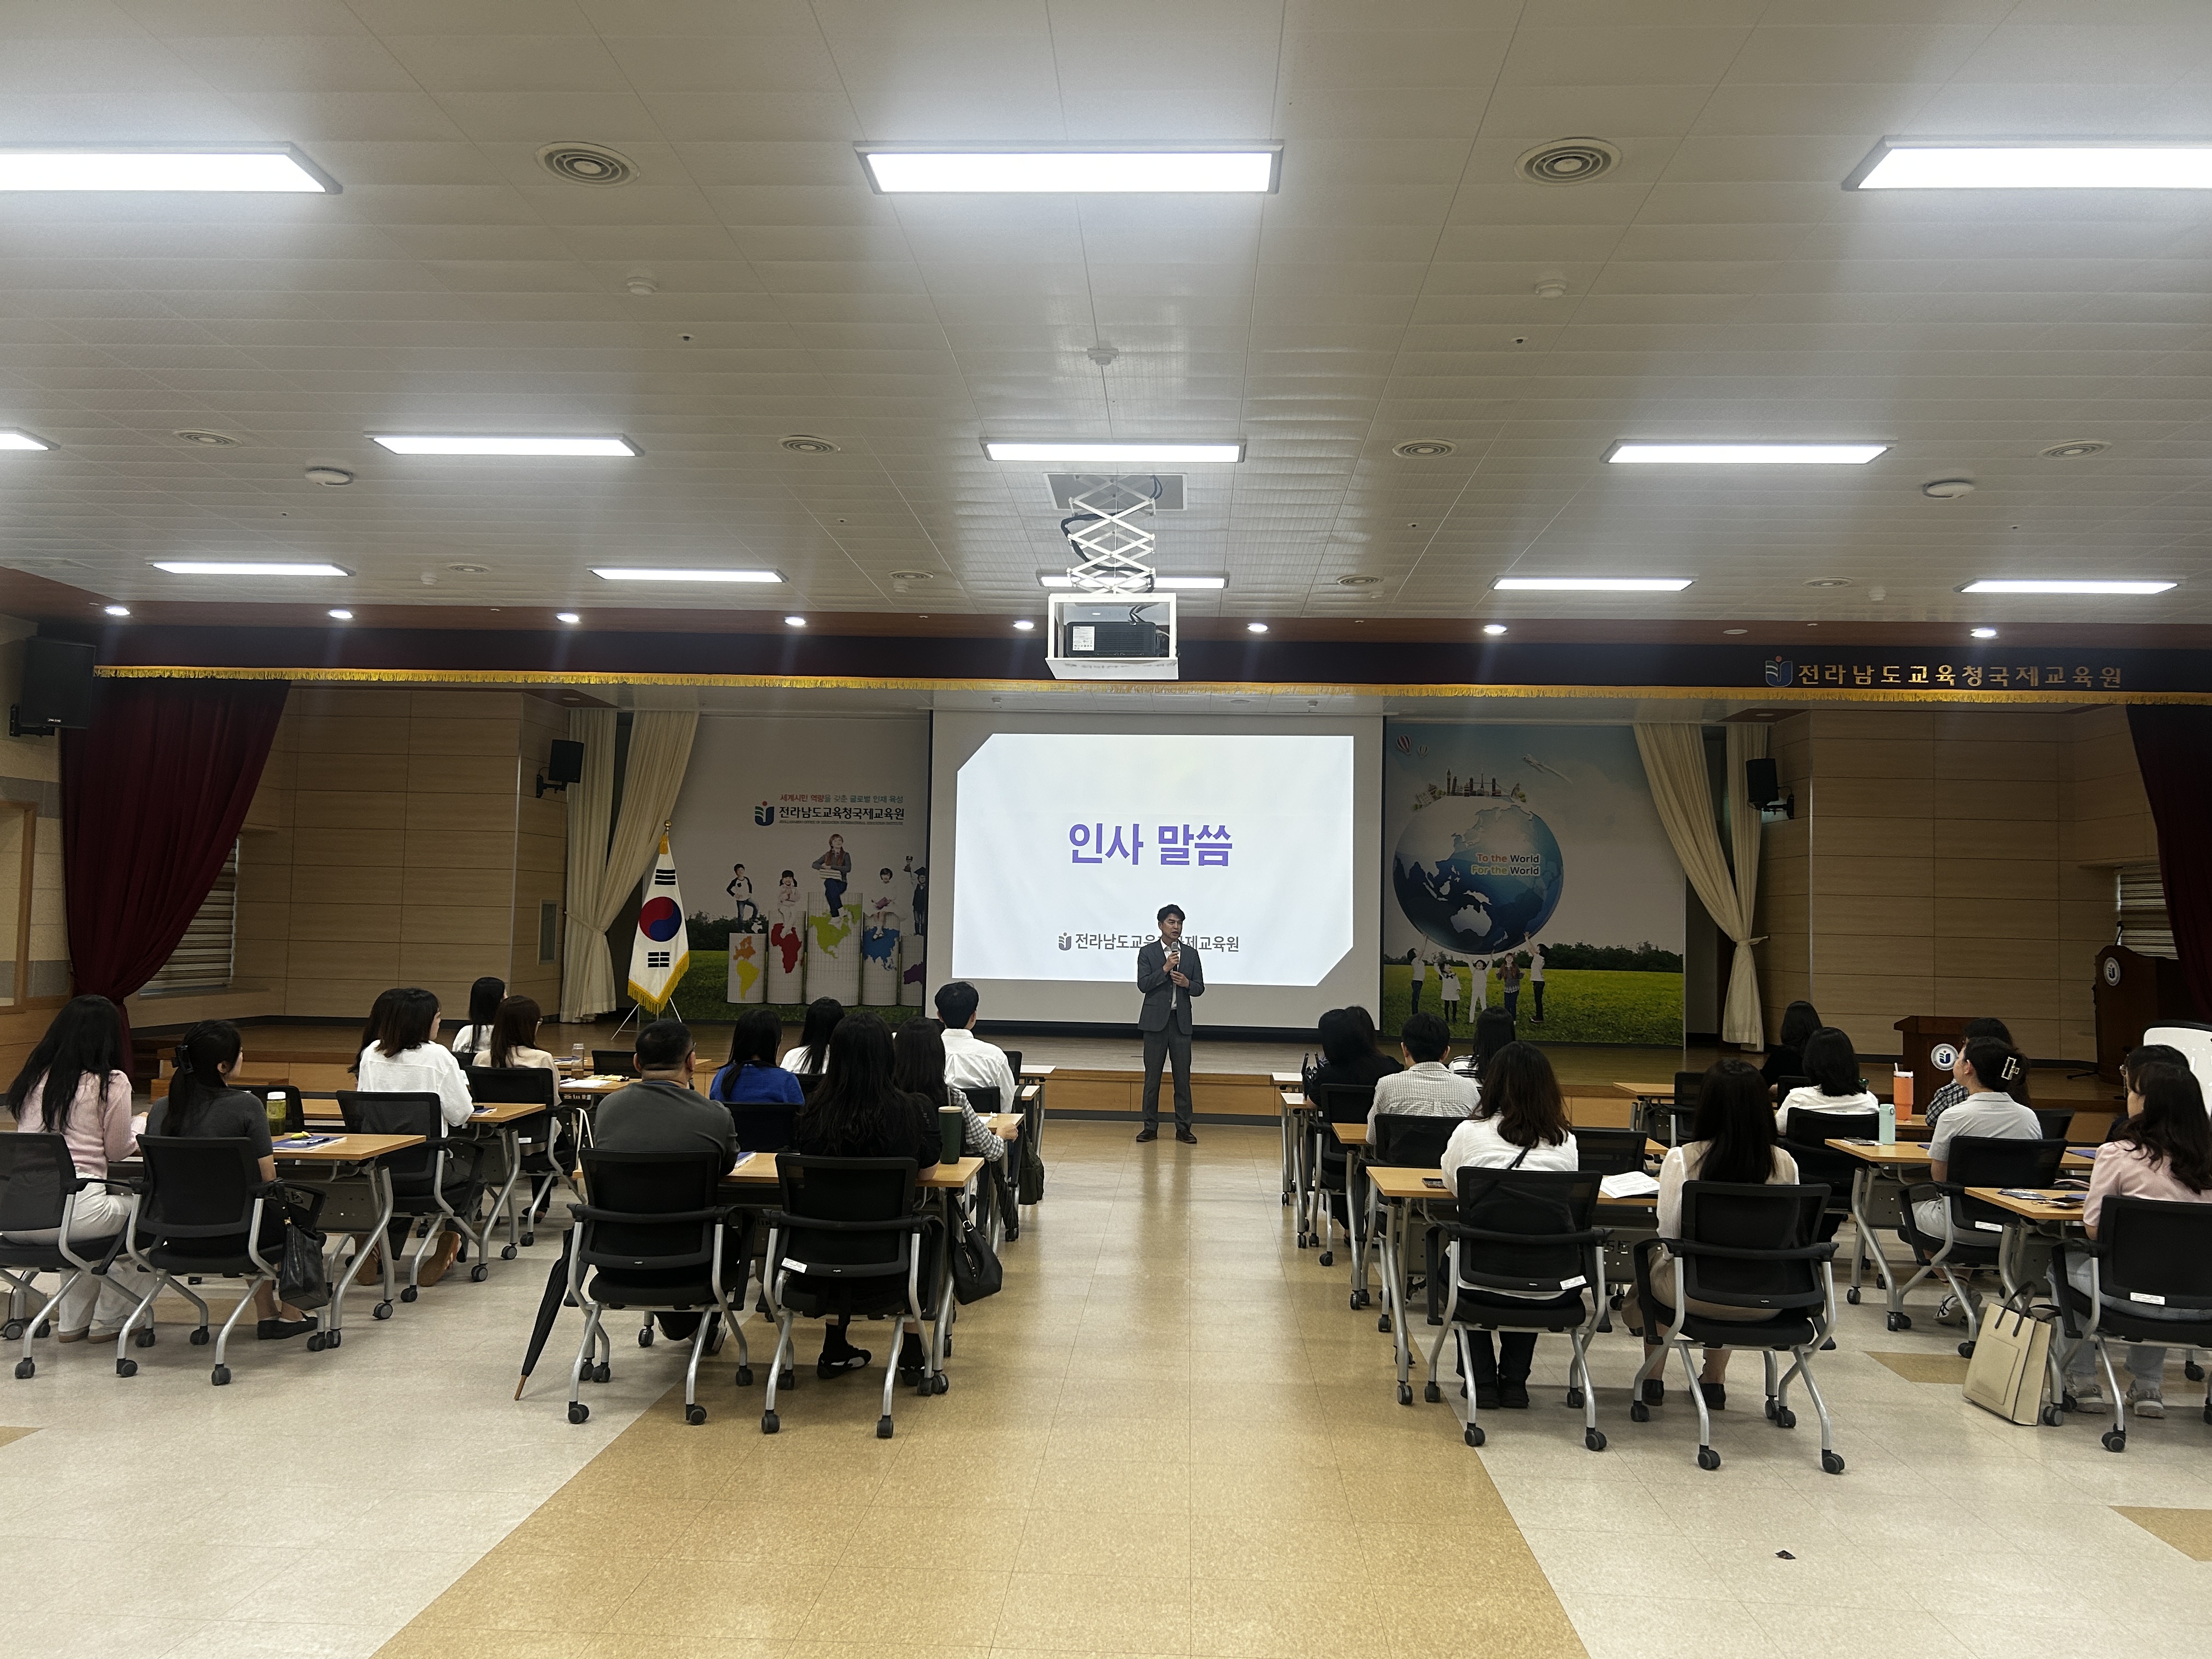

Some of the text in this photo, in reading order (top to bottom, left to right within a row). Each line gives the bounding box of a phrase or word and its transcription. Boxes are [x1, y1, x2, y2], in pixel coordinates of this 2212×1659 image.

[1798, 664, 2122, 688] 전라남도교육청국제교육원
[780, 794, 808, 802] 세계시민
[810, 794, 831, 803] 역량을
[834, 795, 848, 803] 갖춘
[873, 795, 888, 804] 인재
[889, 795, 904, 804] 육성
[778, 806, 905, 820] 전라남도교육청국제교육원
[1069, 823, 1233, 866] 인사 말씀
[1477, 854, 1539, 863] To the World
[1472, 865, 1539, 875] For the World
